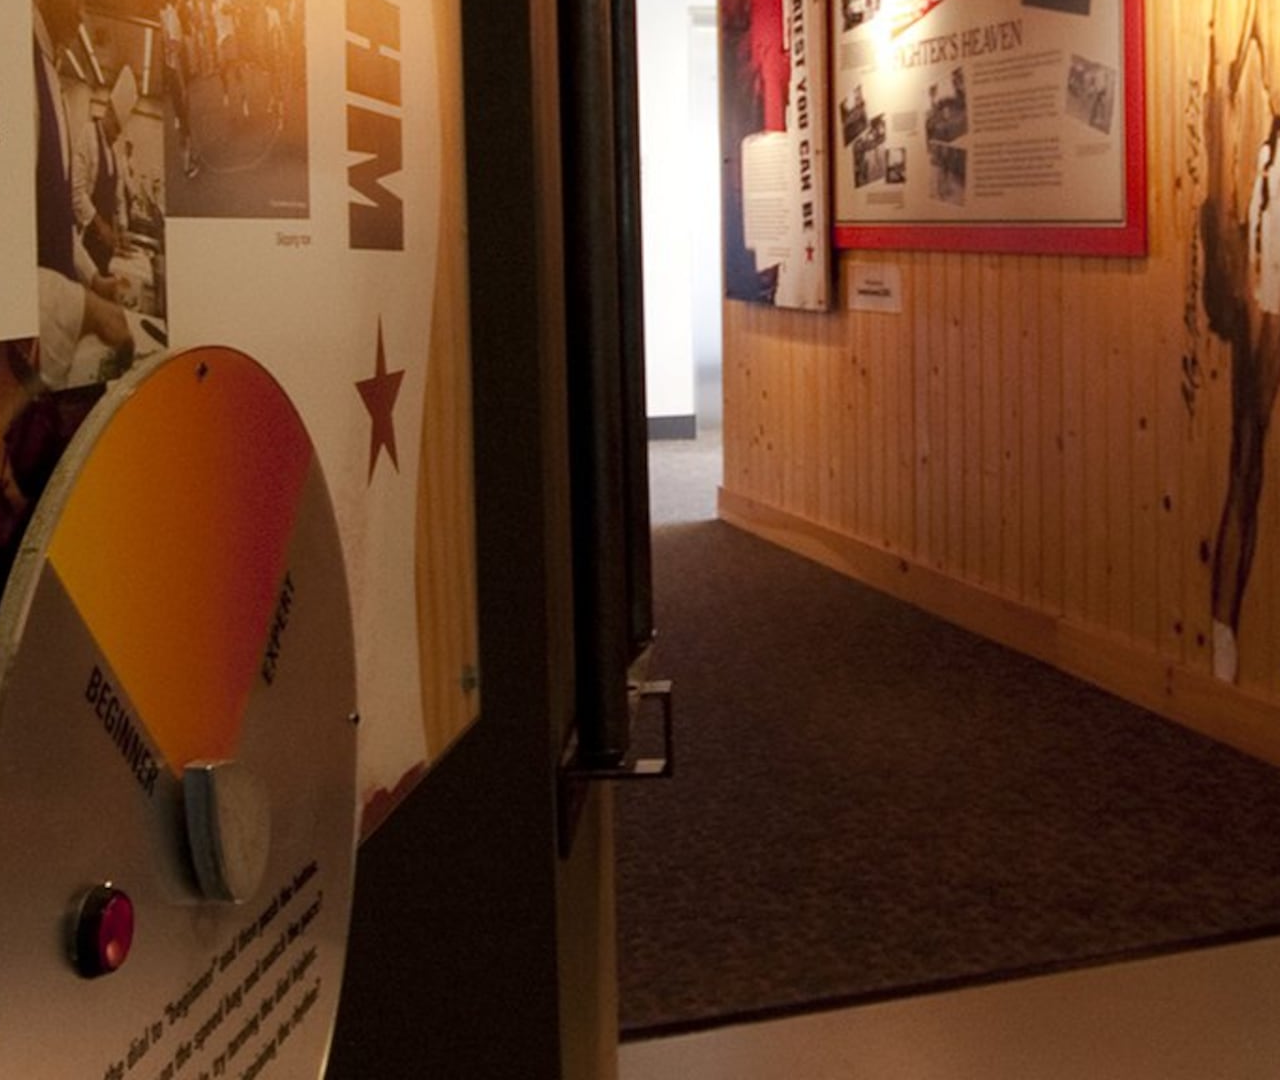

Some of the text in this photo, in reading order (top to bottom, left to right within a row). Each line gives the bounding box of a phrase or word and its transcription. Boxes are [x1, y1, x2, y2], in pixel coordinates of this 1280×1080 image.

[961, 19, 1024, 62] HEAVEN
[795, 76, 811, 132] YOU
[798, 143, 813, 191] CAN
[801, 197, 815, 233] BE
[263, 568, 298, 688] EXPERT
[83, 663, 162, 797] BEGINNER
